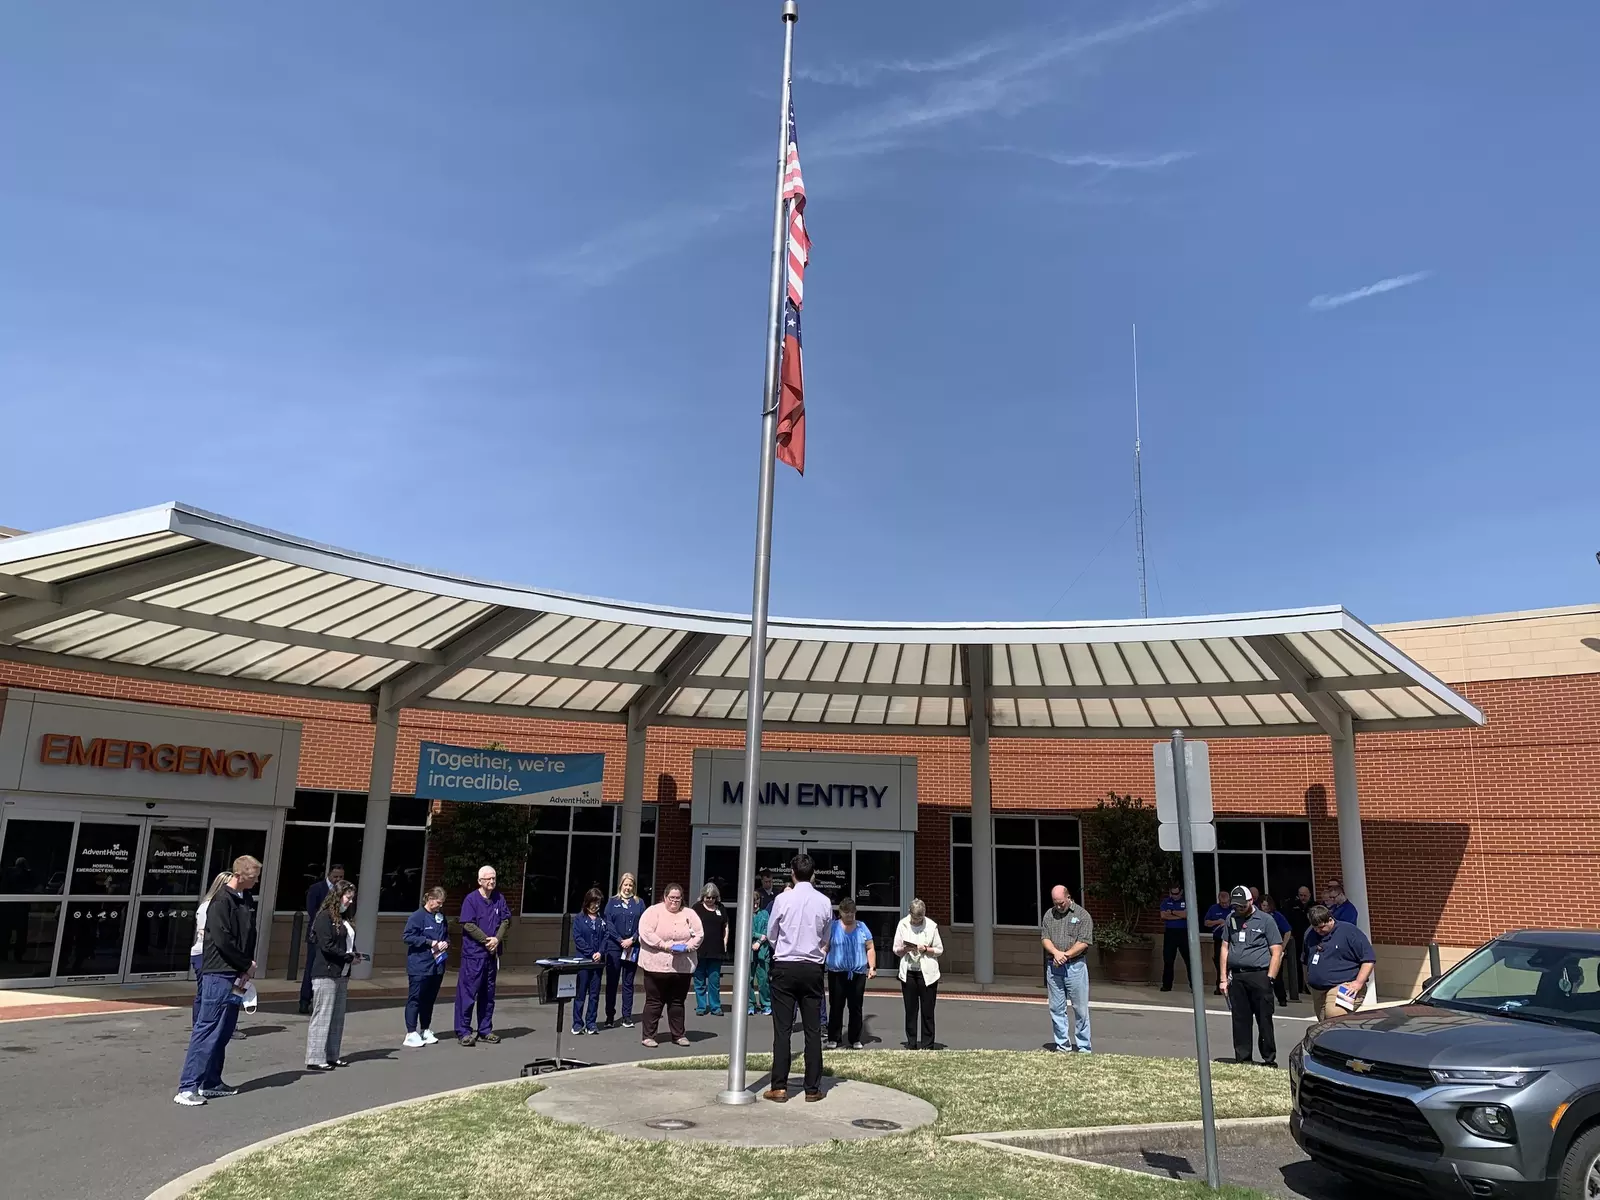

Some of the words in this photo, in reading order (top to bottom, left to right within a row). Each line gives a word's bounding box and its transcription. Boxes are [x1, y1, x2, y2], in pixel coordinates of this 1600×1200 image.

[40, 733, 273, 779] EMERGENCY
[427, 748, 513, 772] Together,
[428, 770, 522, 792] incredible.
[549, 795, 600, 805] AdventHealth
[723, 781, 789, 805] MIN
[798, 783, 888, 808] ENTRY
[82, 848, 128, 856] AdventHealth
[154, 850, 197, 858] AdventHealth
